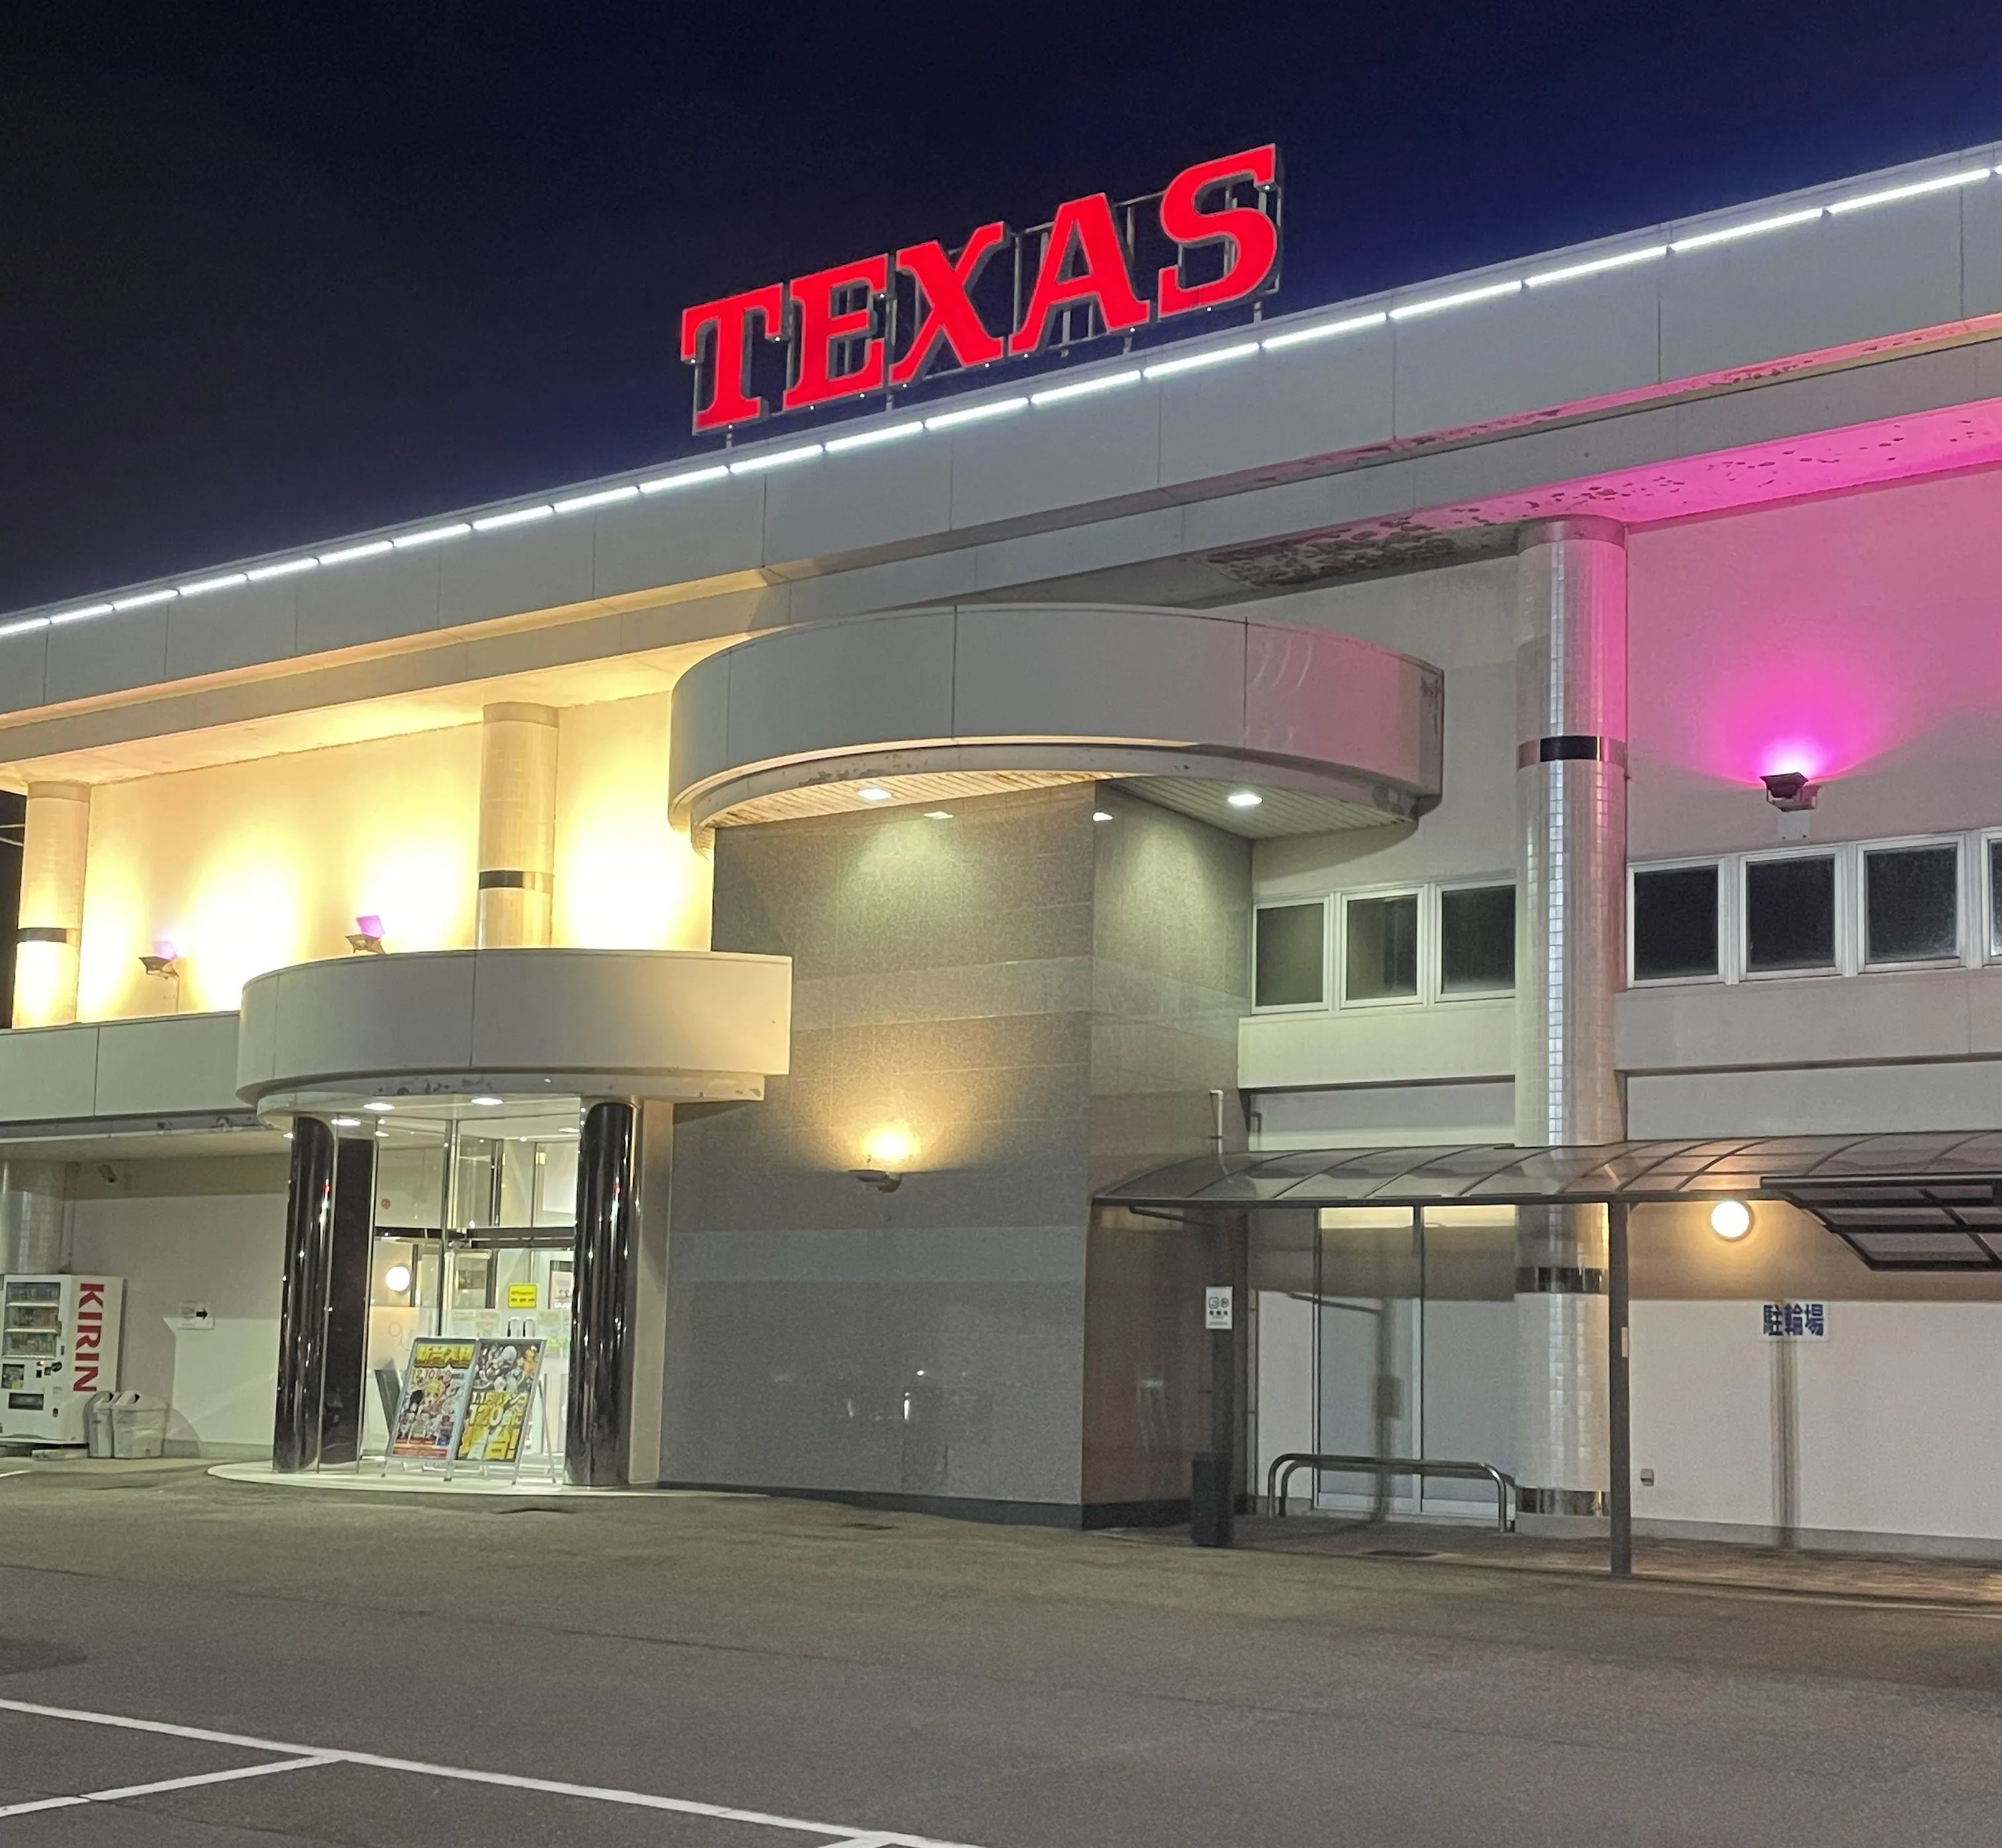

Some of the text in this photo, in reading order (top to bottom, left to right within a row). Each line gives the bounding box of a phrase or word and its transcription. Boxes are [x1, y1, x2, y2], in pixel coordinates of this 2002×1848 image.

[681, 143, 1279, 436] TEXAS
[73, 1283, 105, 1391] KIRIN
[1762, 1303, 1825, 1336] 駐輪場
